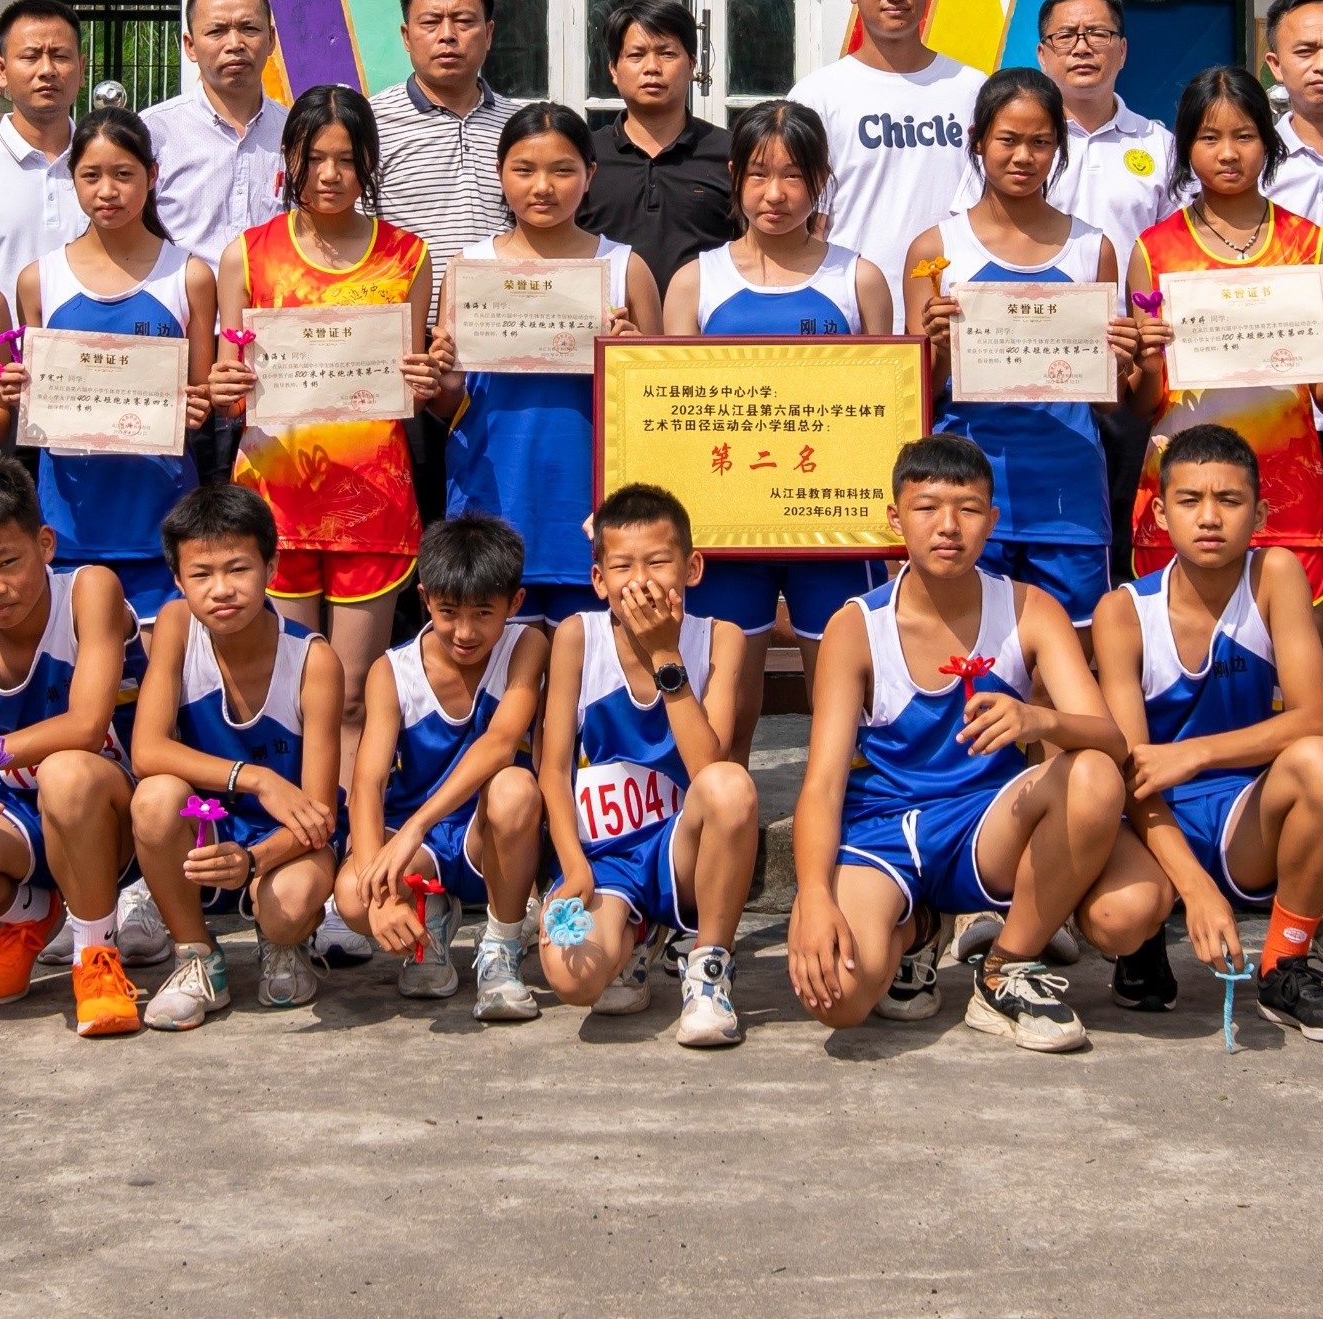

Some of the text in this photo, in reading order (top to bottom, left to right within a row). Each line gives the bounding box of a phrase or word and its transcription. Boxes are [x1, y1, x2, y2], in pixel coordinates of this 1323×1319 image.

[858, 112, 963, 150] Chiclé
[504, 280, 553, 290] 荣誉证书
[1221, 286, 1271, 299] 荣誉证书
[1008, 304, 1057, 314] 荣誉证书
[134, 321, 171, 336] 刚边
[303, 327, 352, 338] 荣誉证书
[800, 318, 839, 335] 刚边
[81, 353, 129, 365] 荣誉证书
[671, 404, 886, 418] 2023年从江县第六届中小学生体育
[642, 419, 831, 432] 艺术节田径运动会小学组总分：
[711, 442, 818, 476] 第二名
[770, 487, 884, 500] 从江县教育和科技局
[783, 506, 869, 518] 2023年6月13日
